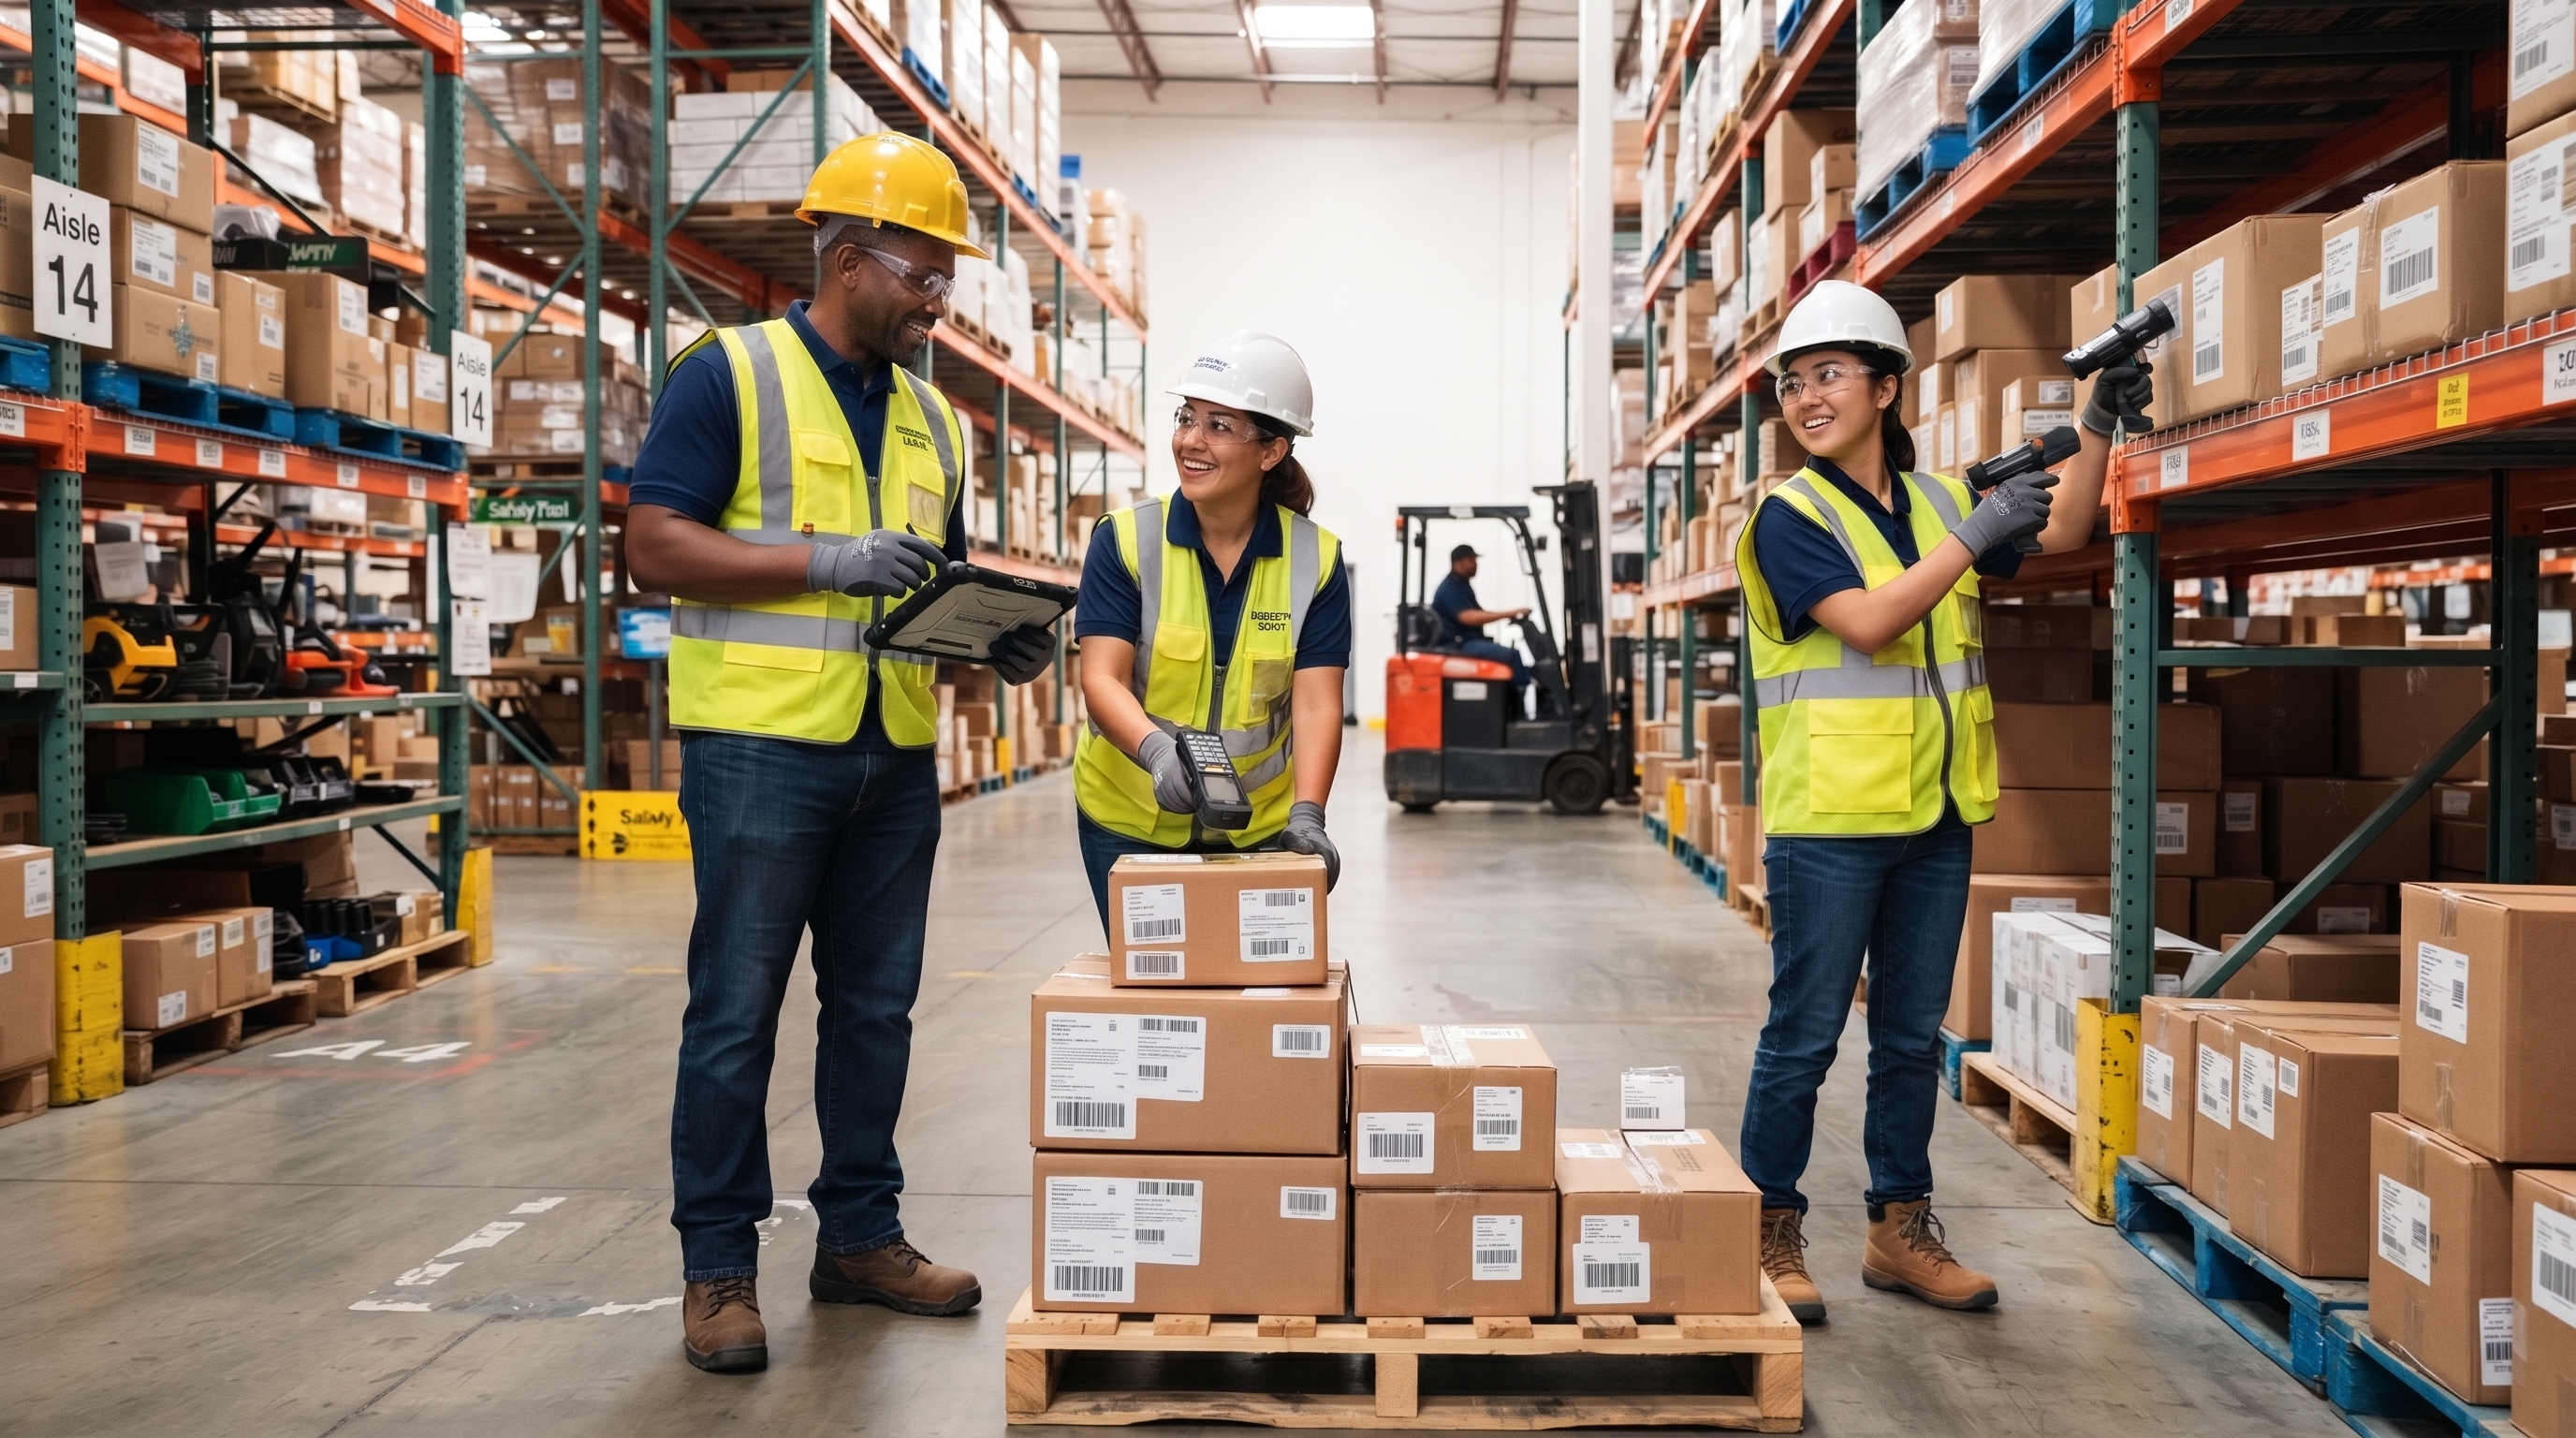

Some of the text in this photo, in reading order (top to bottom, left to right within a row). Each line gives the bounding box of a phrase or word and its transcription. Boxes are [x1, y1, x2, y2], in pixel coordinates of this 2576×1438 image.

[43, 202, 100, 245] Aisle
[49, 255, 99, 323] 14
[457, 352, 486, 377] Aisle
[460, 387, 485, 432] 14
[269, 1039, 473, 1064] A4
